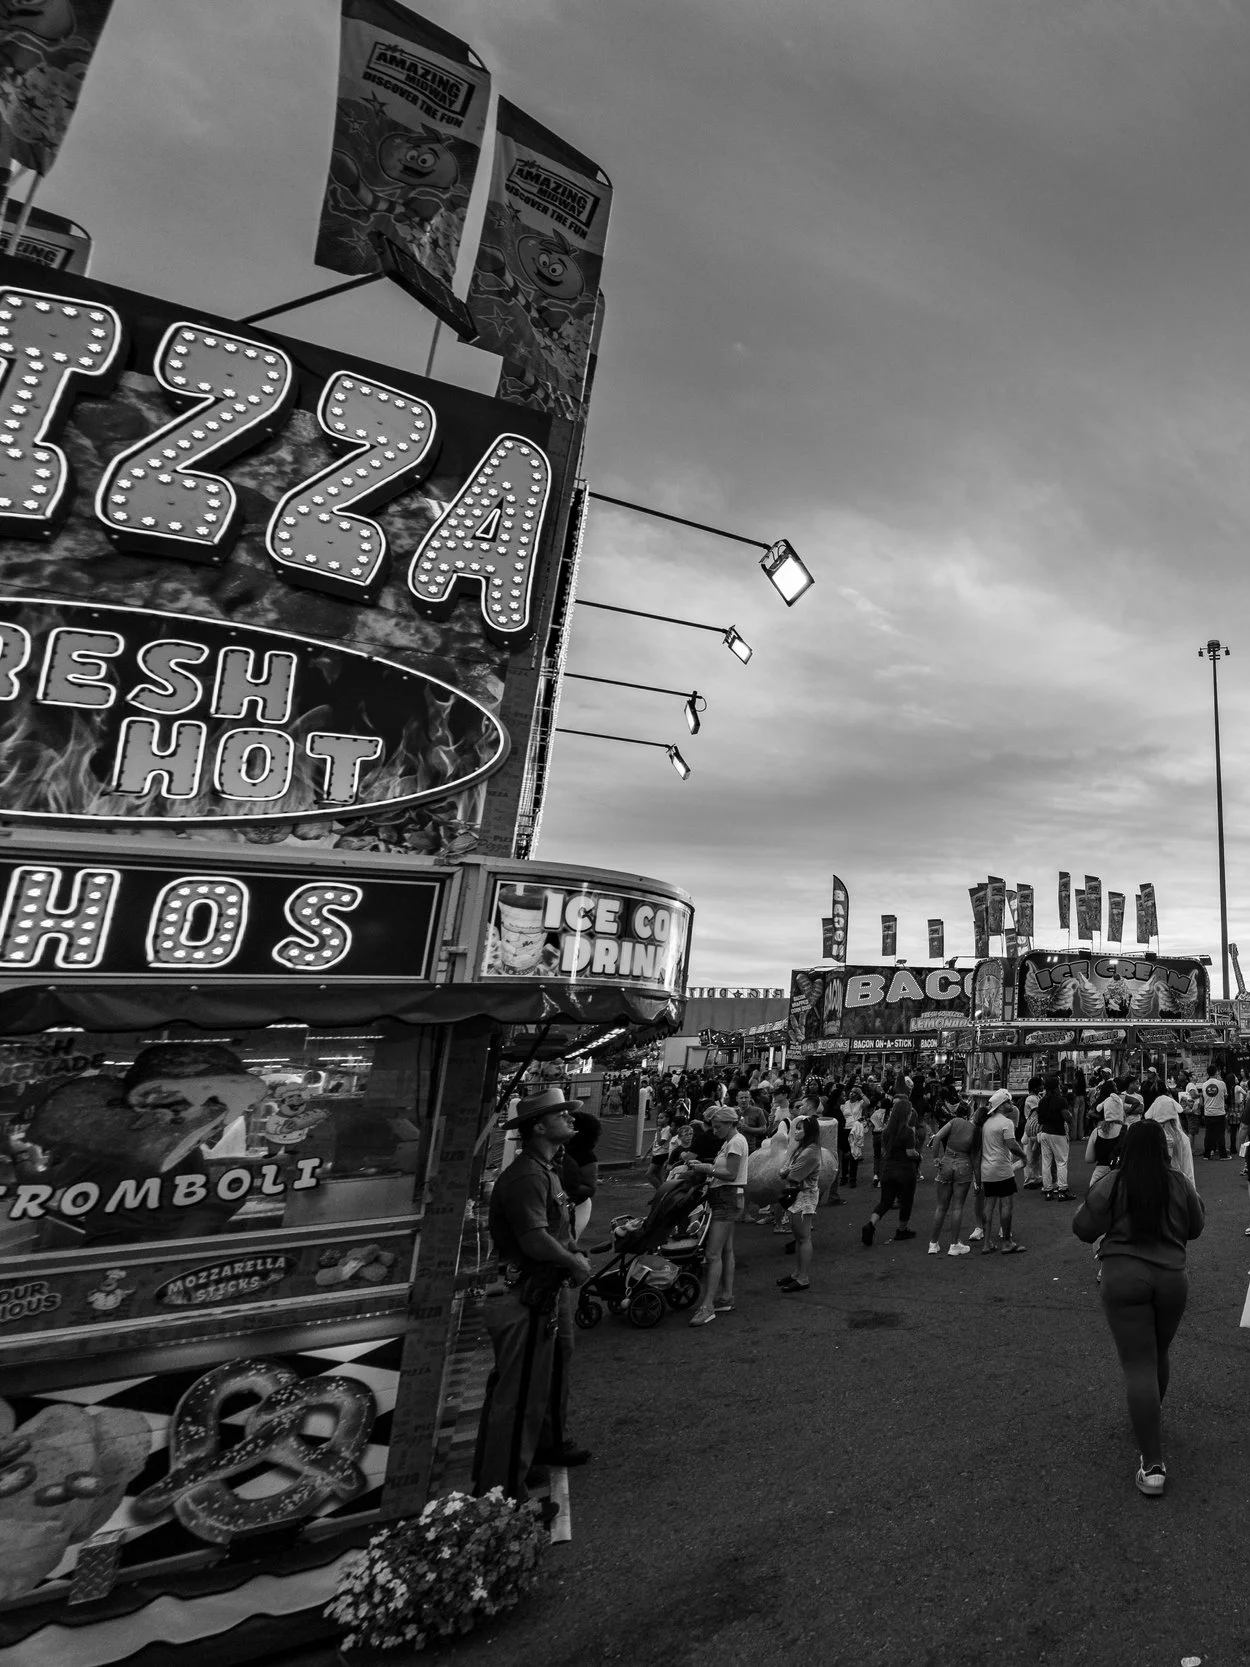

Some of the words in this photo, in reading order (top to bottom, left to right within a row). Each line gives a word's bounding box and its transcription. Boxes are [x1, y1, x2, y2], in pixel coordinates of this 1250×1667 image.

[375, 51, 461, 100] AMAZING
[404, 72, 457, 109] MIDWAY
[362, 71, 419, 106] DISCOVER
[418, 99, 439, 120] THE
[438, 114, 464, 129] FUN
[515, 166, 588, 211] AMAZING
[537, 185, 584, 218] MIDWAY
[504, 182, 550, 214] DISCOVER
[550, 210, 569, 228] THE
[567, 221, 589, 240] FUN
[112, 717, 382, 803] HOT
[0, 866, 363, 971] HOS
[544, 891, 621, 935] ICE
[1035, 960, 1090, 992] ICE
[1094, 959, 1191, 994] CREAM
[853, 1040, 875, 1048] BACON
[911, 1017, 970, 1032] LEMONAD
[920, 1039, 938, 1048] BACON
[0, 1158, 322, 1220] ROMBOLI
[167, 1256, 286, 1296] MOZZARELLA
[196, 1277, 261, 1303] STICKS
